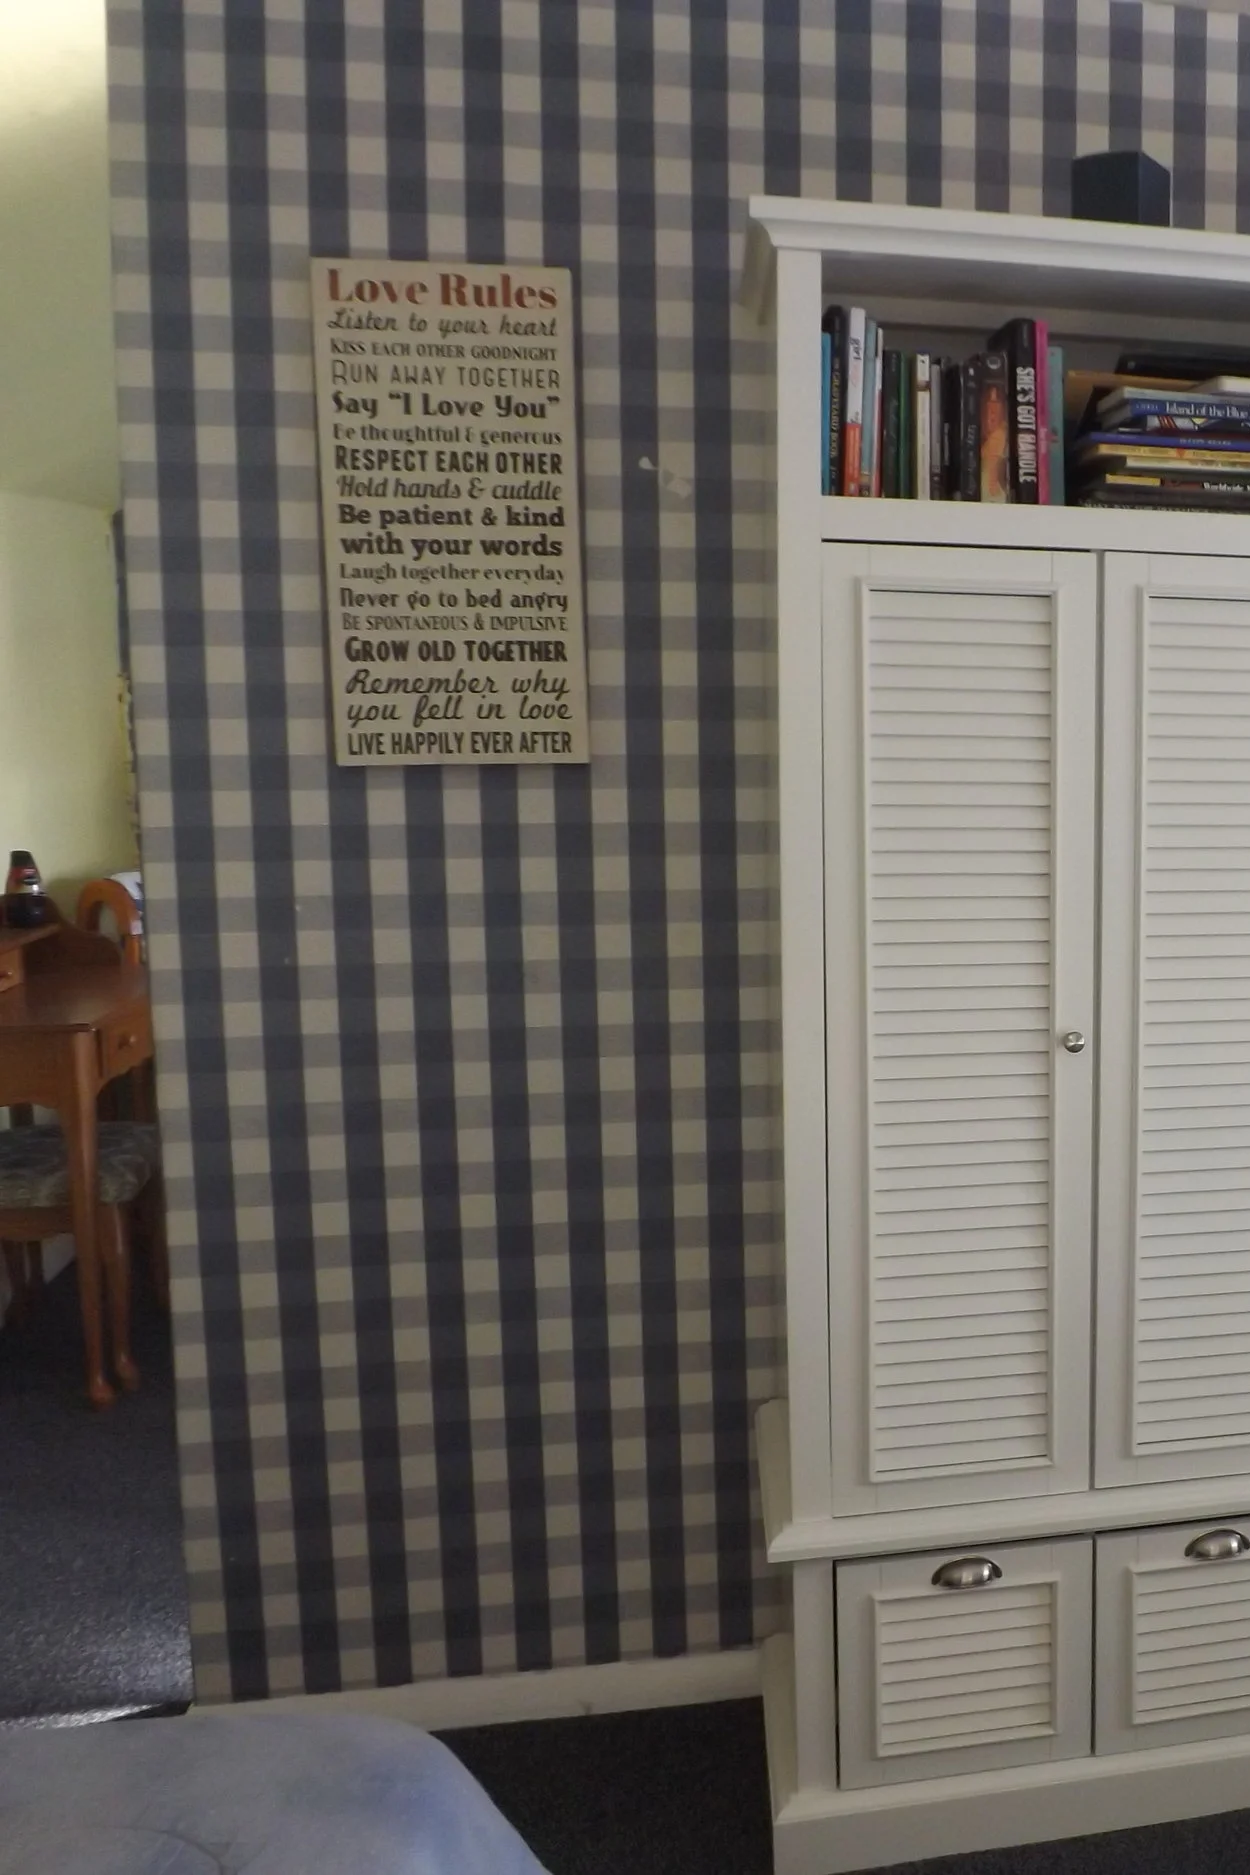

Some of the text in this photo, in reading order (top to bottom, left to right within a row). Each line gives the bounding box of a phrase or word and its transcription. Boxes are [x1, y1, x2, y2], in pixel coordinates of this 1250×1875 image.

[327, 269, 558, 309] Love Rules
[327, 308, 558, 338] Listen to your heart
[330, 338, 557, 361] KISS EACH OTHER GOODNIGHT
[332, 359, 560, 389] RUN AWAY TOGETHER
[332, 390, 378, 419] Say
[422, 394, 484, 417] Love
[1166, 401, 1195, 416] Island
[1196, 403, 1209, 416] of
[1209, 404, 1225, 418] the
[1226, 406, 1249, 420] Blue
[333, 424, 356, 440] Be
[361, 424, 460, 444] thoughtful
[480, 430, 562, 447] generous
[1016, 366, 1037, 484] SHE'S GOT HANDLE
[335, 445, 563, 475] RESPECT EACH OTHER
[337, 475, 562, 501] Hold hands & cuddle
[338, 504, 565, 529] Be patient & kind
[340, 532, 563, 561] with your words
[340, 563, 564, 585] Laugh together everyday
[340, 587, 568, 612] Never go to bed angry
[365, 614, 468, 631] SPONTANEOUS
[473, 613, 485, 630] &
[490, 616, 568, 632] IMPULSIVE
[345, 636, 568, 662] GROW OLD TOGETHER
[345, 668, 570, 702] Remember why
[347, 694, 573, 728] you fell in love
[348, 731, 572, 755] LIVE HAPPILY EVER AFTER
